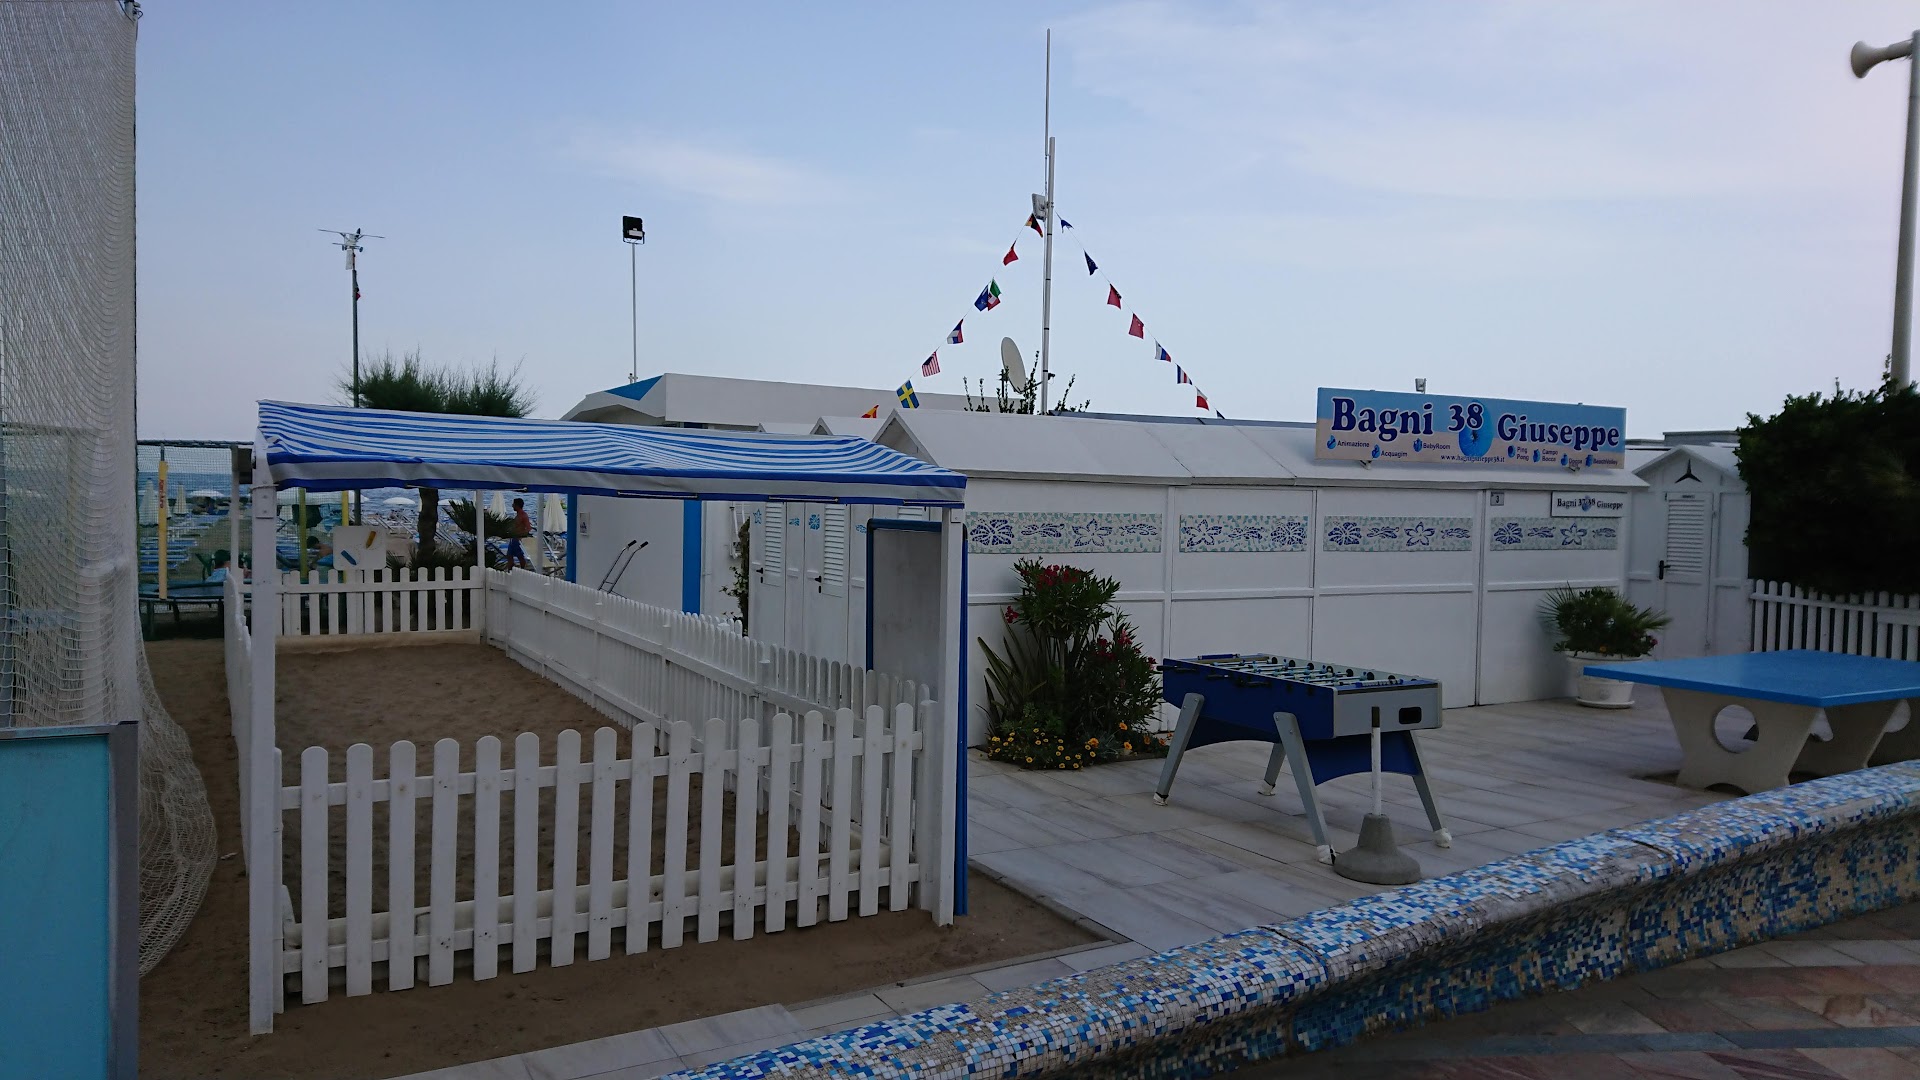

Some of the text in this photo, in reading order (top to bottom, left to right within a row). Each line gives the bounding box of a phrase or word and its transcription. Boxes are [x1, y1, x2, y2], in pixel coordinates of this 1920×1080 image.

[1331, 397, 1620, 452] Bagni 38 Giuseppe
[1337, 440, 1370, 448] Animazione
[1516, 446, 1528, 454] Ping
[1516, 454, 1529, 462] Pong
[1557, 498, 1577, 509] Bagni
[1596, 500, 1624, 510] Giuseppe
